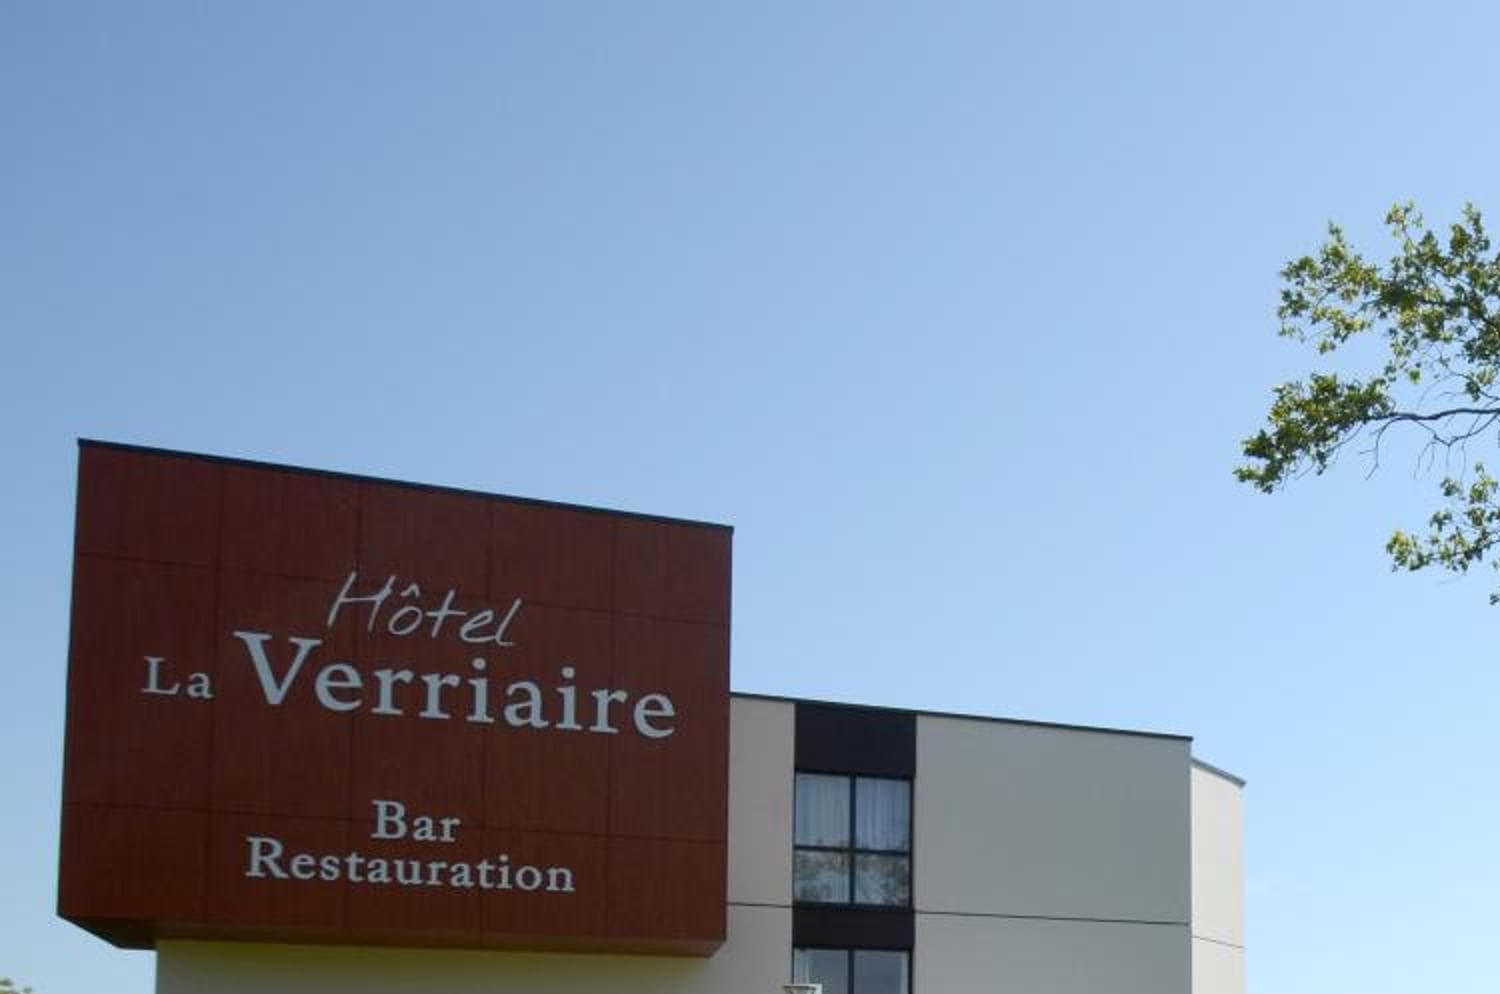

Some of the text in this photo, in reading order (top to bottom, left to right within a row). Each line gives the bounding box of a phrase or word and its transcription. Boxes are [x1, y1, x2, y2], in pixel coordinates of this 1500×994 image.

[326, 572, 523, 647] Hôtel
[142, 630, 676, 739] La Verriaire
[371, 800, 461, 843] Bar
[245, 837, 575, 893] Restauration
